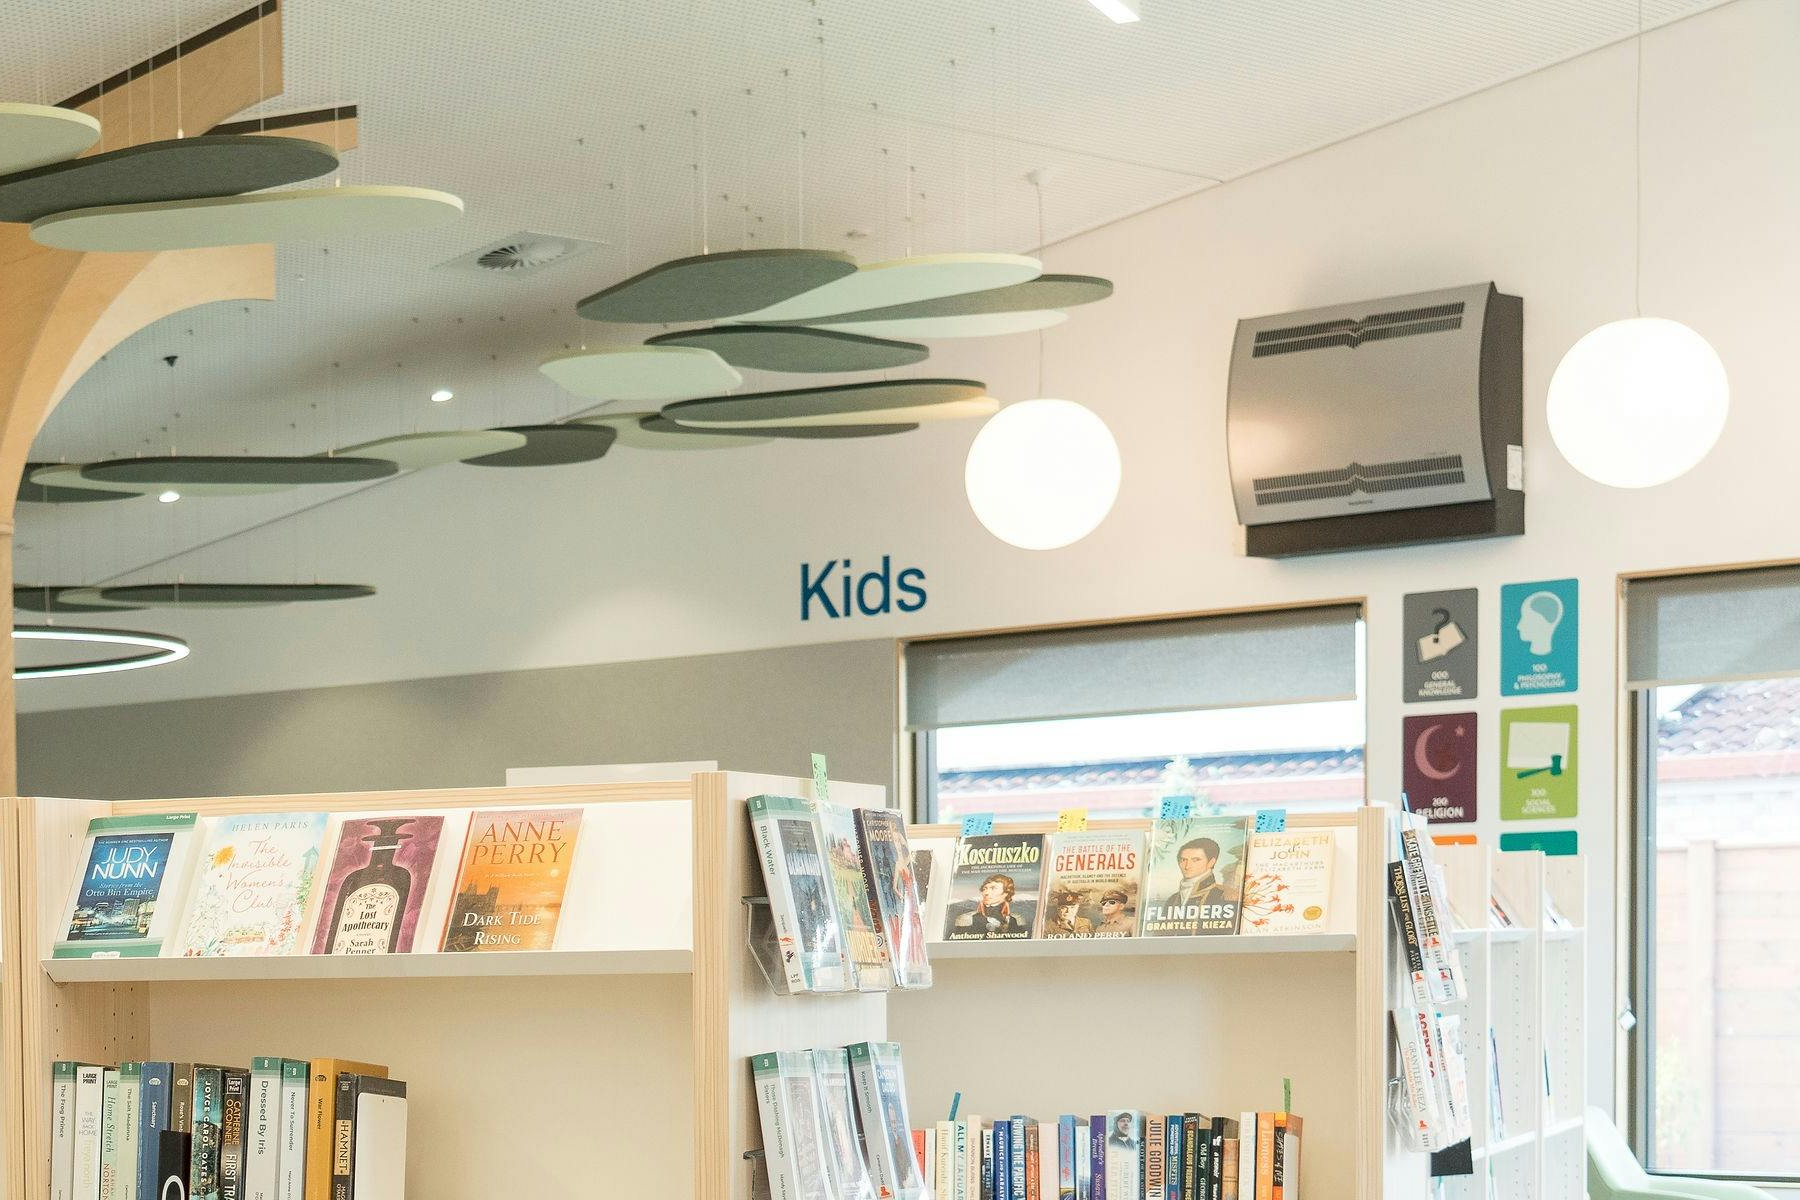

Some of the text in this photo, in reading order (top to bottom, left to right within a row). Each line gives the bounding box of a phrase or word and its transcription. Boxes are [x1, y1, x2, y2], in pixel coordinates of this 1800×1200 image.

[801, 555, 926, 621] Kids
[1531, 663, 1548, 673] 100
[1431, 796, 1449, 807] 200
[230, 820, 310, 834] HELEN PARIS
[479, 820, 566, 844] ANNE
[248, 838, 277, 854] The
[470, 841, 568, 866] PERRY
[957, 841, 1040, 866] Kosciuszko
[100, 845, 158, 865] JUDY
[1054, 851, 1137, 873] GENERALS
[90, 862, 159, 880] NUNN
[85, 887, 154, 900] Otto Bin Empire
[363, 901, 377, 911] The
[1145, 903, 1236, 922] FLINDERS
[358, 909, 378, 921] Lost
[341, 919, 391, 933] Apothecary
[1145, 919, 1233, 931] GRANTLEE KIEZA
[349, 937, 375, 948] Sarah
[947, 930, 1029, 942] Anthony Sharwood
[232, 1101, 241, 1146] CATHERINE
[200, 1080, 212, 1184] JOYCE CAROL OATES
